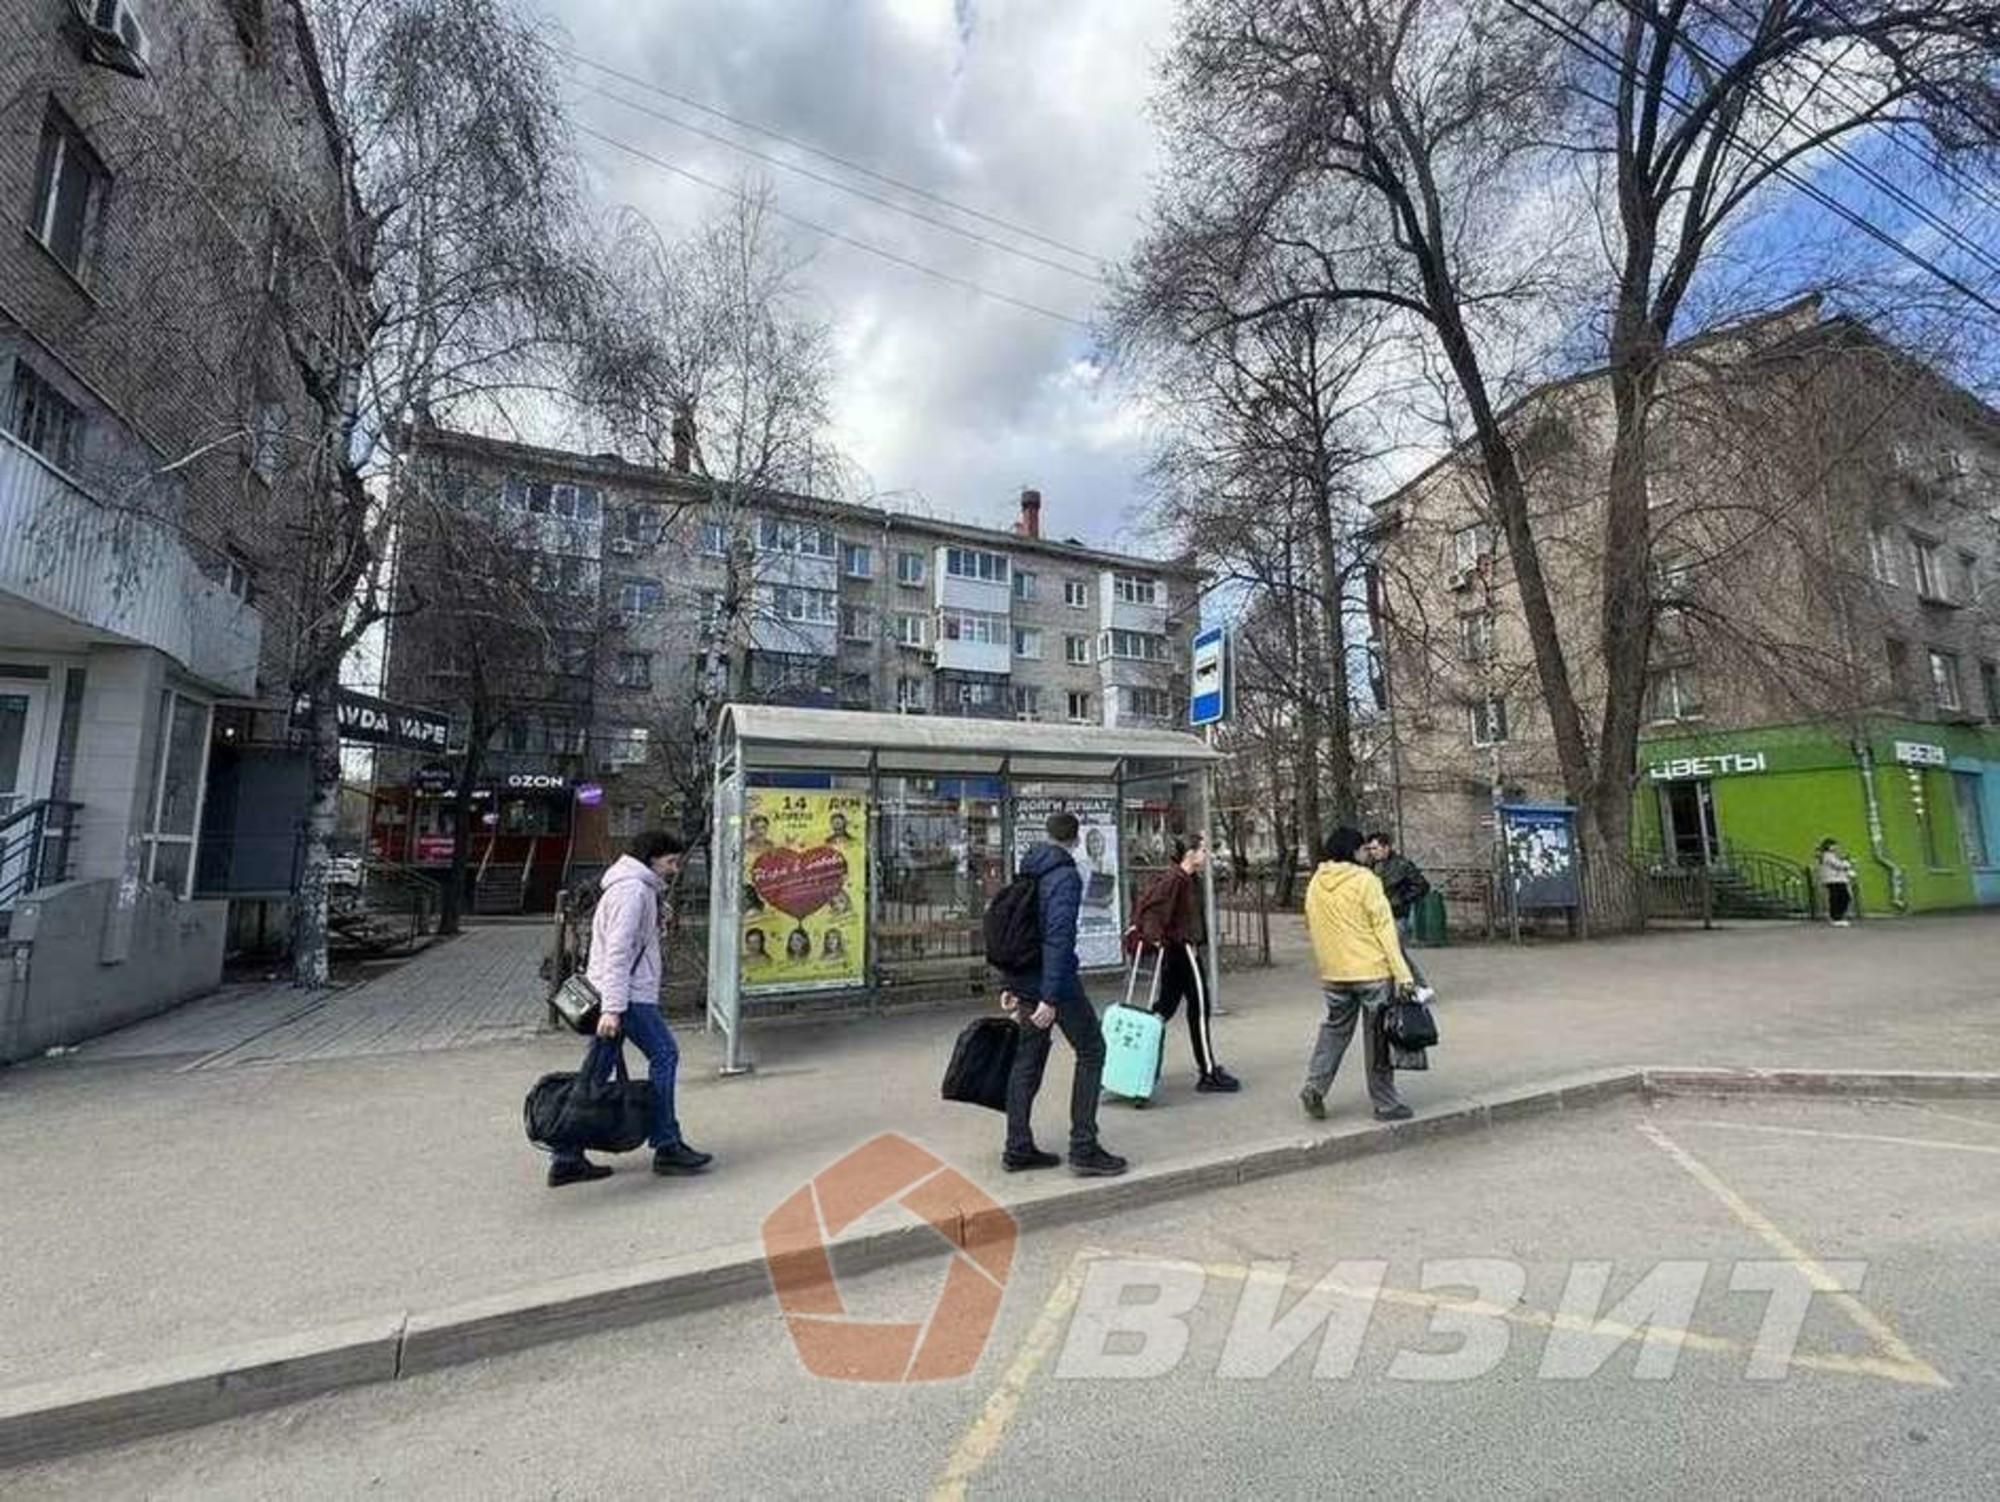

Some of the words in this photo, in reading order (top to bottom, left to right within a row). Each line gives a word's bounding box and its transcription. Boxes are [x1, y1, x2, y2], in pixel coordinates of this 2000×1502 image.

[399, 716, 446, 744] VAPE
[1649, 752, 1766, 780] ЦВЕТЫ
[508, 775, 564, 788] OZON
[784, 796, 807, 810] 14
[1016, 799, 1062, 812] ДОЛГИ
